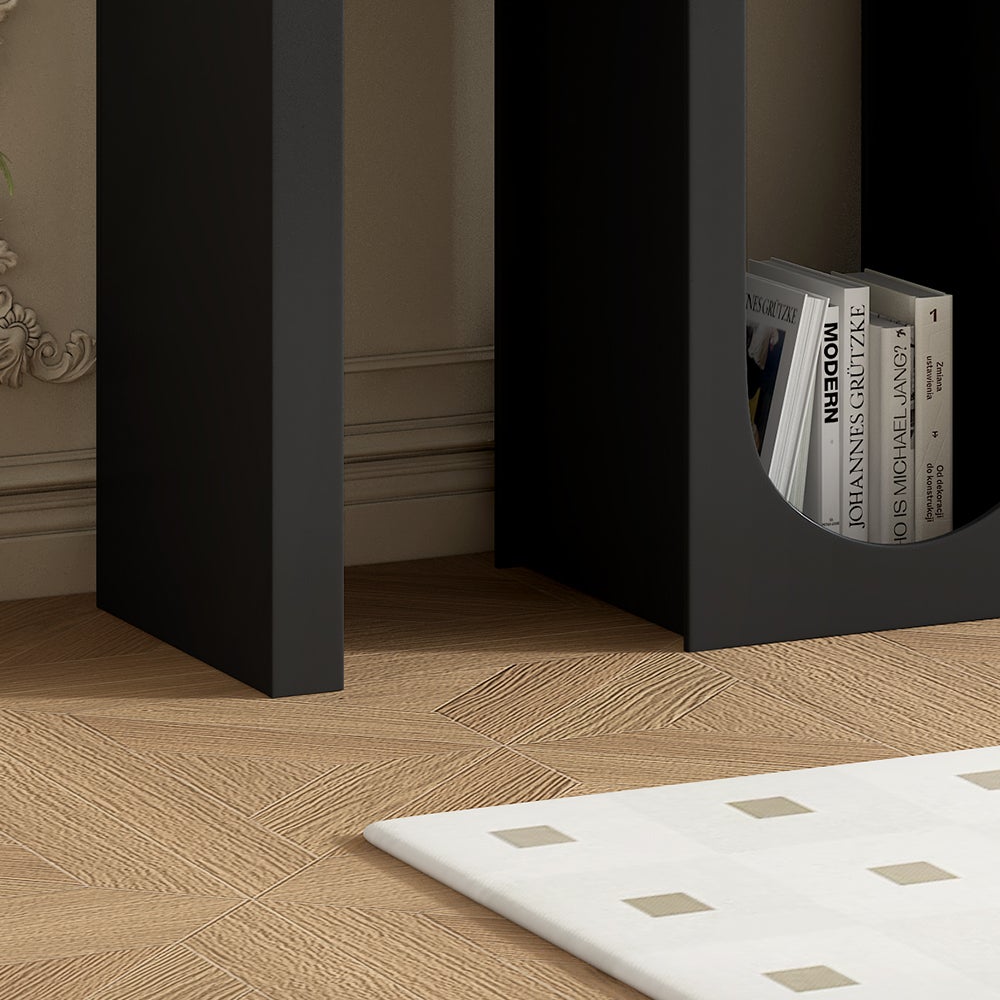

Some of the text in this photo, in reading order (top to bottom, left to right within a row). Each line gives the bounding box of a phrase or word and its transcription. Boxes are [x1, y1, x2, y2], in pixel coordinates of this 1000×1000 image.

[929, 308, 938, 322] 1
[823, 322, 839, 424] MODERN
[893, 345, 908, 406] JANG?
[926, 355, 934, 401] ustawienia
[936, 361, 944, 392] Zmiana
[846, 303, 866, 529] JOHANNES GRÜTZKE
[893, 408, 908, 496] MICHAEL
[893, 499, 907, 518] IS
[925, 462, 934, 523] do konstrukcji
[935, 464, 944, 518] Od dekoracji
